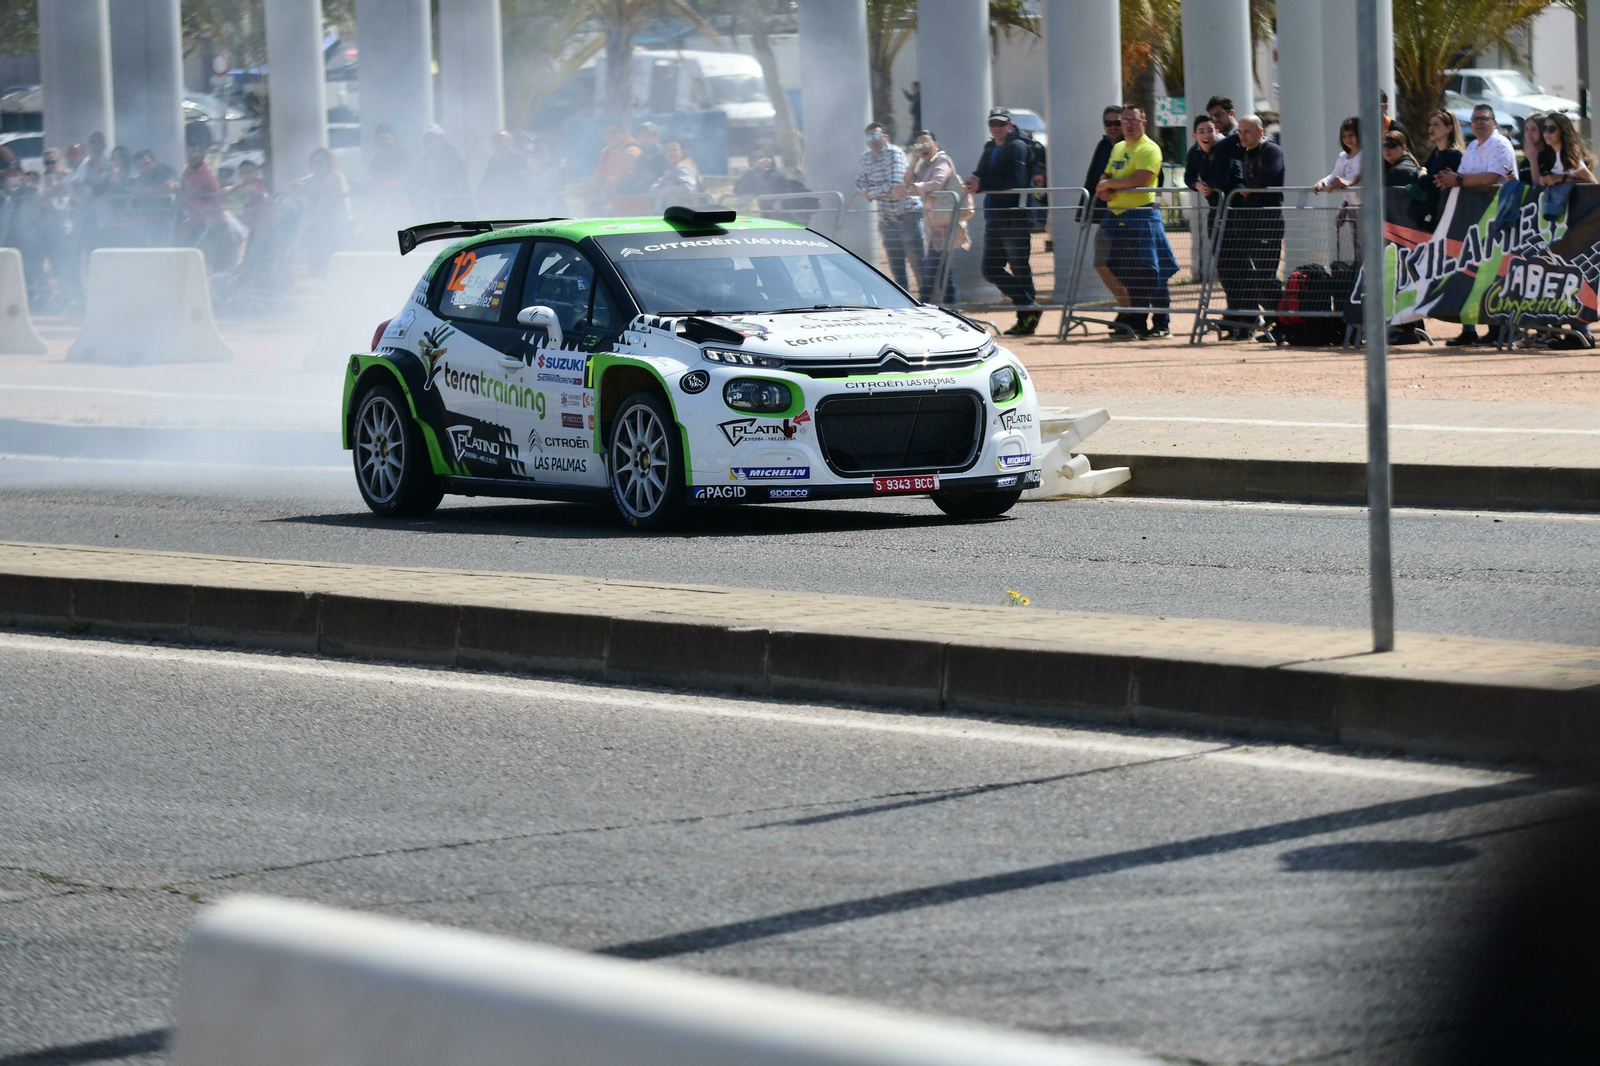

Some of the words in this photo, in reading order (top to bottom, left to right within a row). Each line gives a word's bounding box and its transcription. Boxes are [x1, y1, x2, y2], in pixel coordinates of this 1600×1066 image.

[744, 237, 771, 245] LAS
[773, 238, 829, 248] PALMAS
[447, 250, 477, 291] 12
[1498, 264, 1579, 308] JABER
[582, 334, 598, 346] C3
[545, 356, 585, 372] SUZUKI
[907, 378, 922, 387] LAS
[923, 377, 956, 387] PALMAS
[1006, 413, 1032, 428] PLATINO
[732, 425, 797, 438] PLATINO
[457, 433, 500, 455] PLATINO
[534, 456, 550, 470] LAS
[551, 457, 587, 473] PALMAS
[749, 469, 806, 477] MICHELIN
[875, 480, 883, 491] S
[886, 479, 911, 490] 9343
[914, 478, 933, 489] BCC
[706, 486, 747, 498] PAGID
[770, 488, 808, 498] sparco
